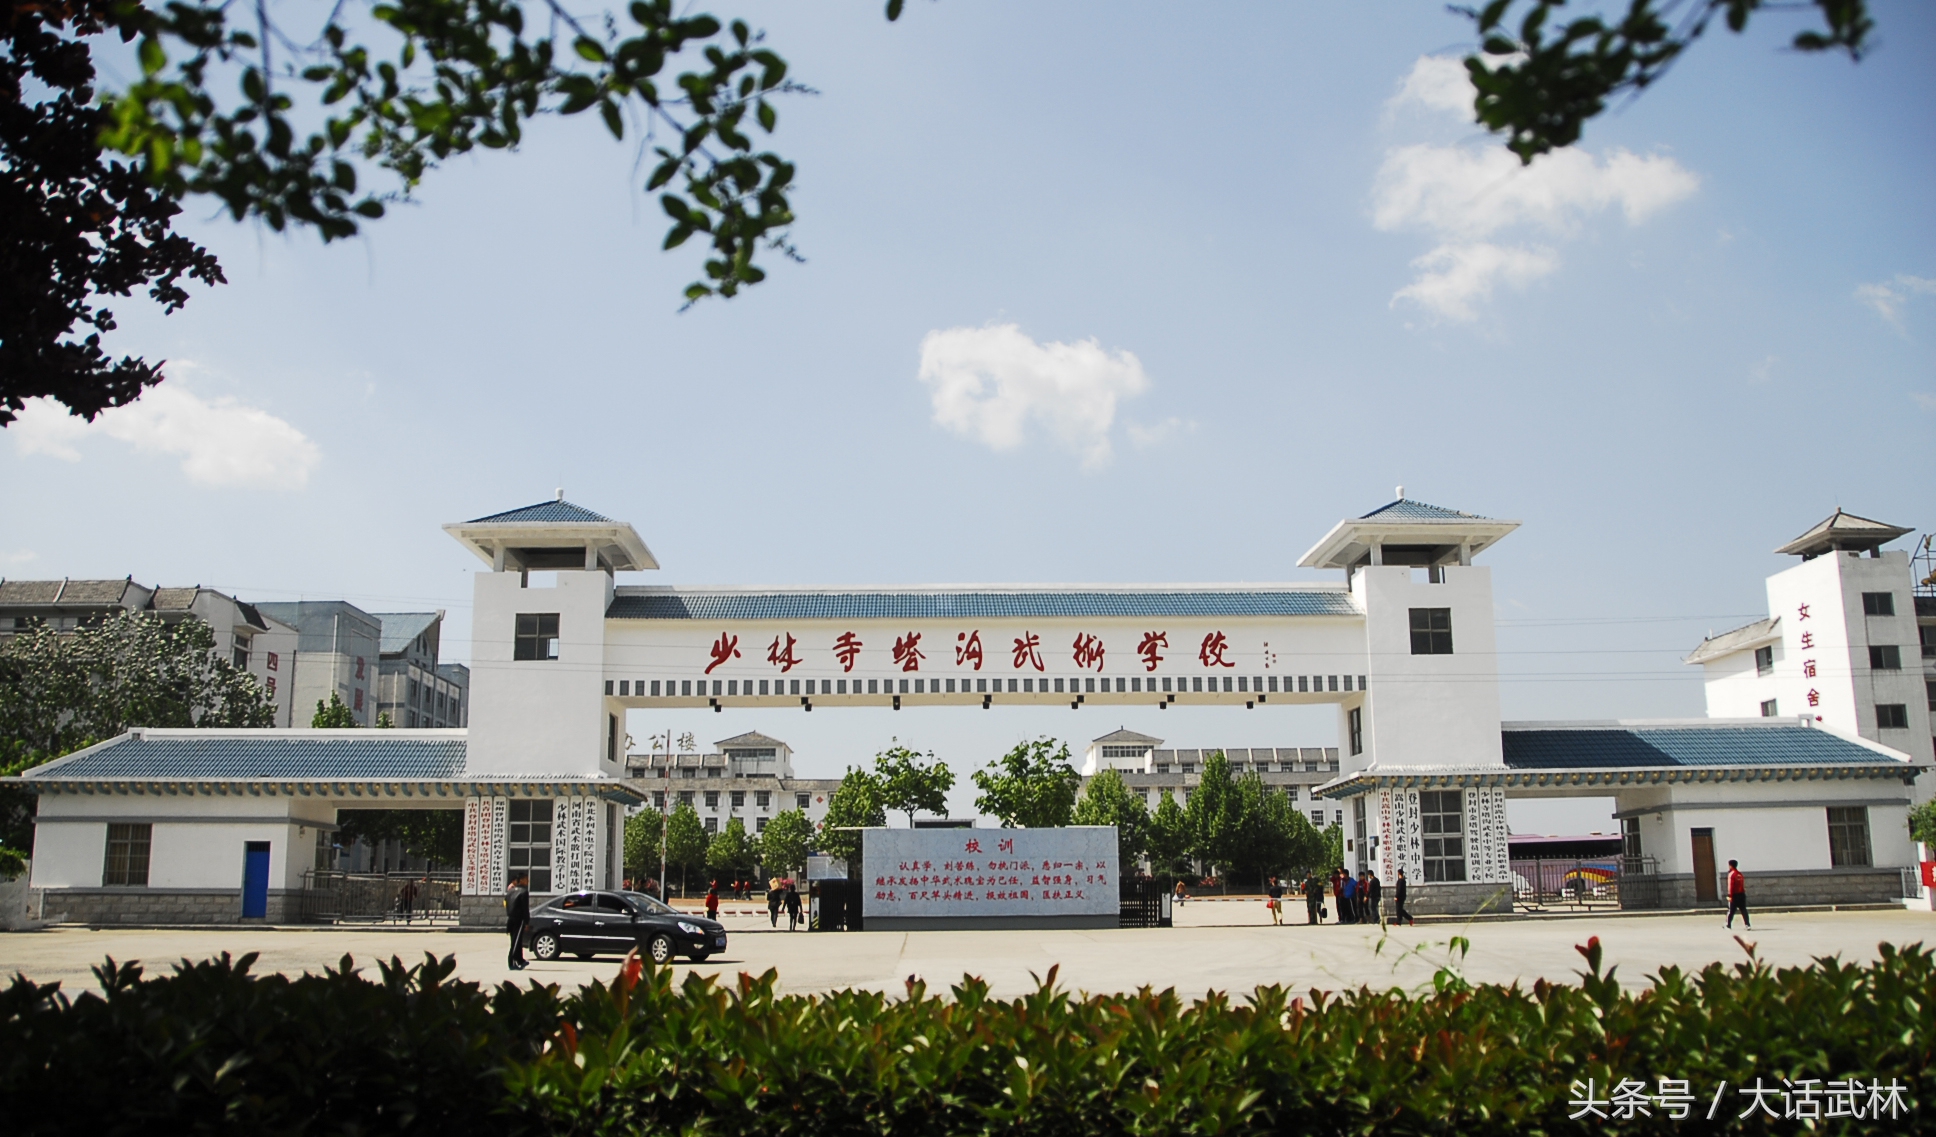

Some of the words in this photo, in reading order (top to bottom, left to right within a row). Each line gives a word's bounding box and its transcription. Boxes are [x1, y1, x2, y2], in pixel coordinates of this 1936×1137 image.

[1798, 603, 1823, 722] 女生宿舍
[555, 803, 567, 889] 少林武术国际教学中心
[570, 801, 581, 893] 河南省武术散打训练基地
[965, 838, 1014, 855] 校训
[1395, 793, 1407, 879] 嵩山少林武术职业学
[1409, 792, 1421, 881] 登封少林中学
[1468, 792, 1481, 881] 登封市金塔驾驶员培训学校
